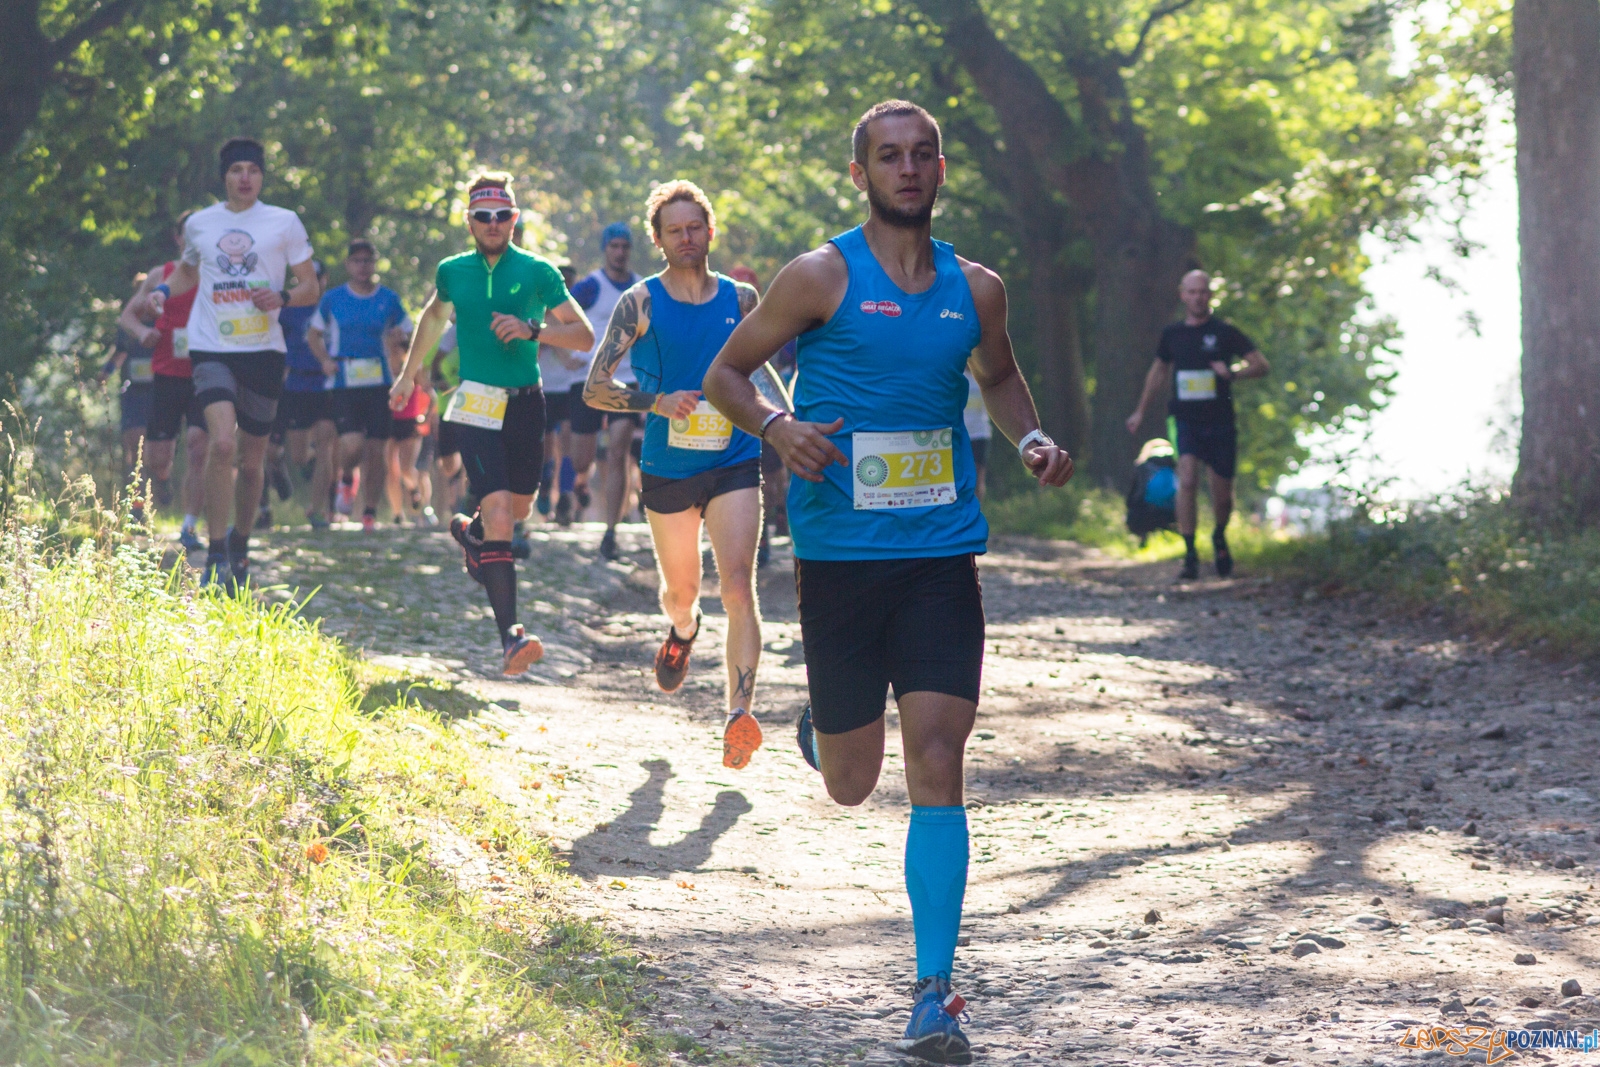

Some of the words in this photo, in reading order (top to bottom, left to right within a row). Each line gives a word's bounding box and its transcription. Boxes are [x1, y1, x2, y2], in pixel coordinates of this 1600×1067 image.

[213, 288, 251, 304] RUNN
[471, 397, 500, 414] 287
[697, 415, 727, 432] 552
[900, 452, 942, 479] 273
